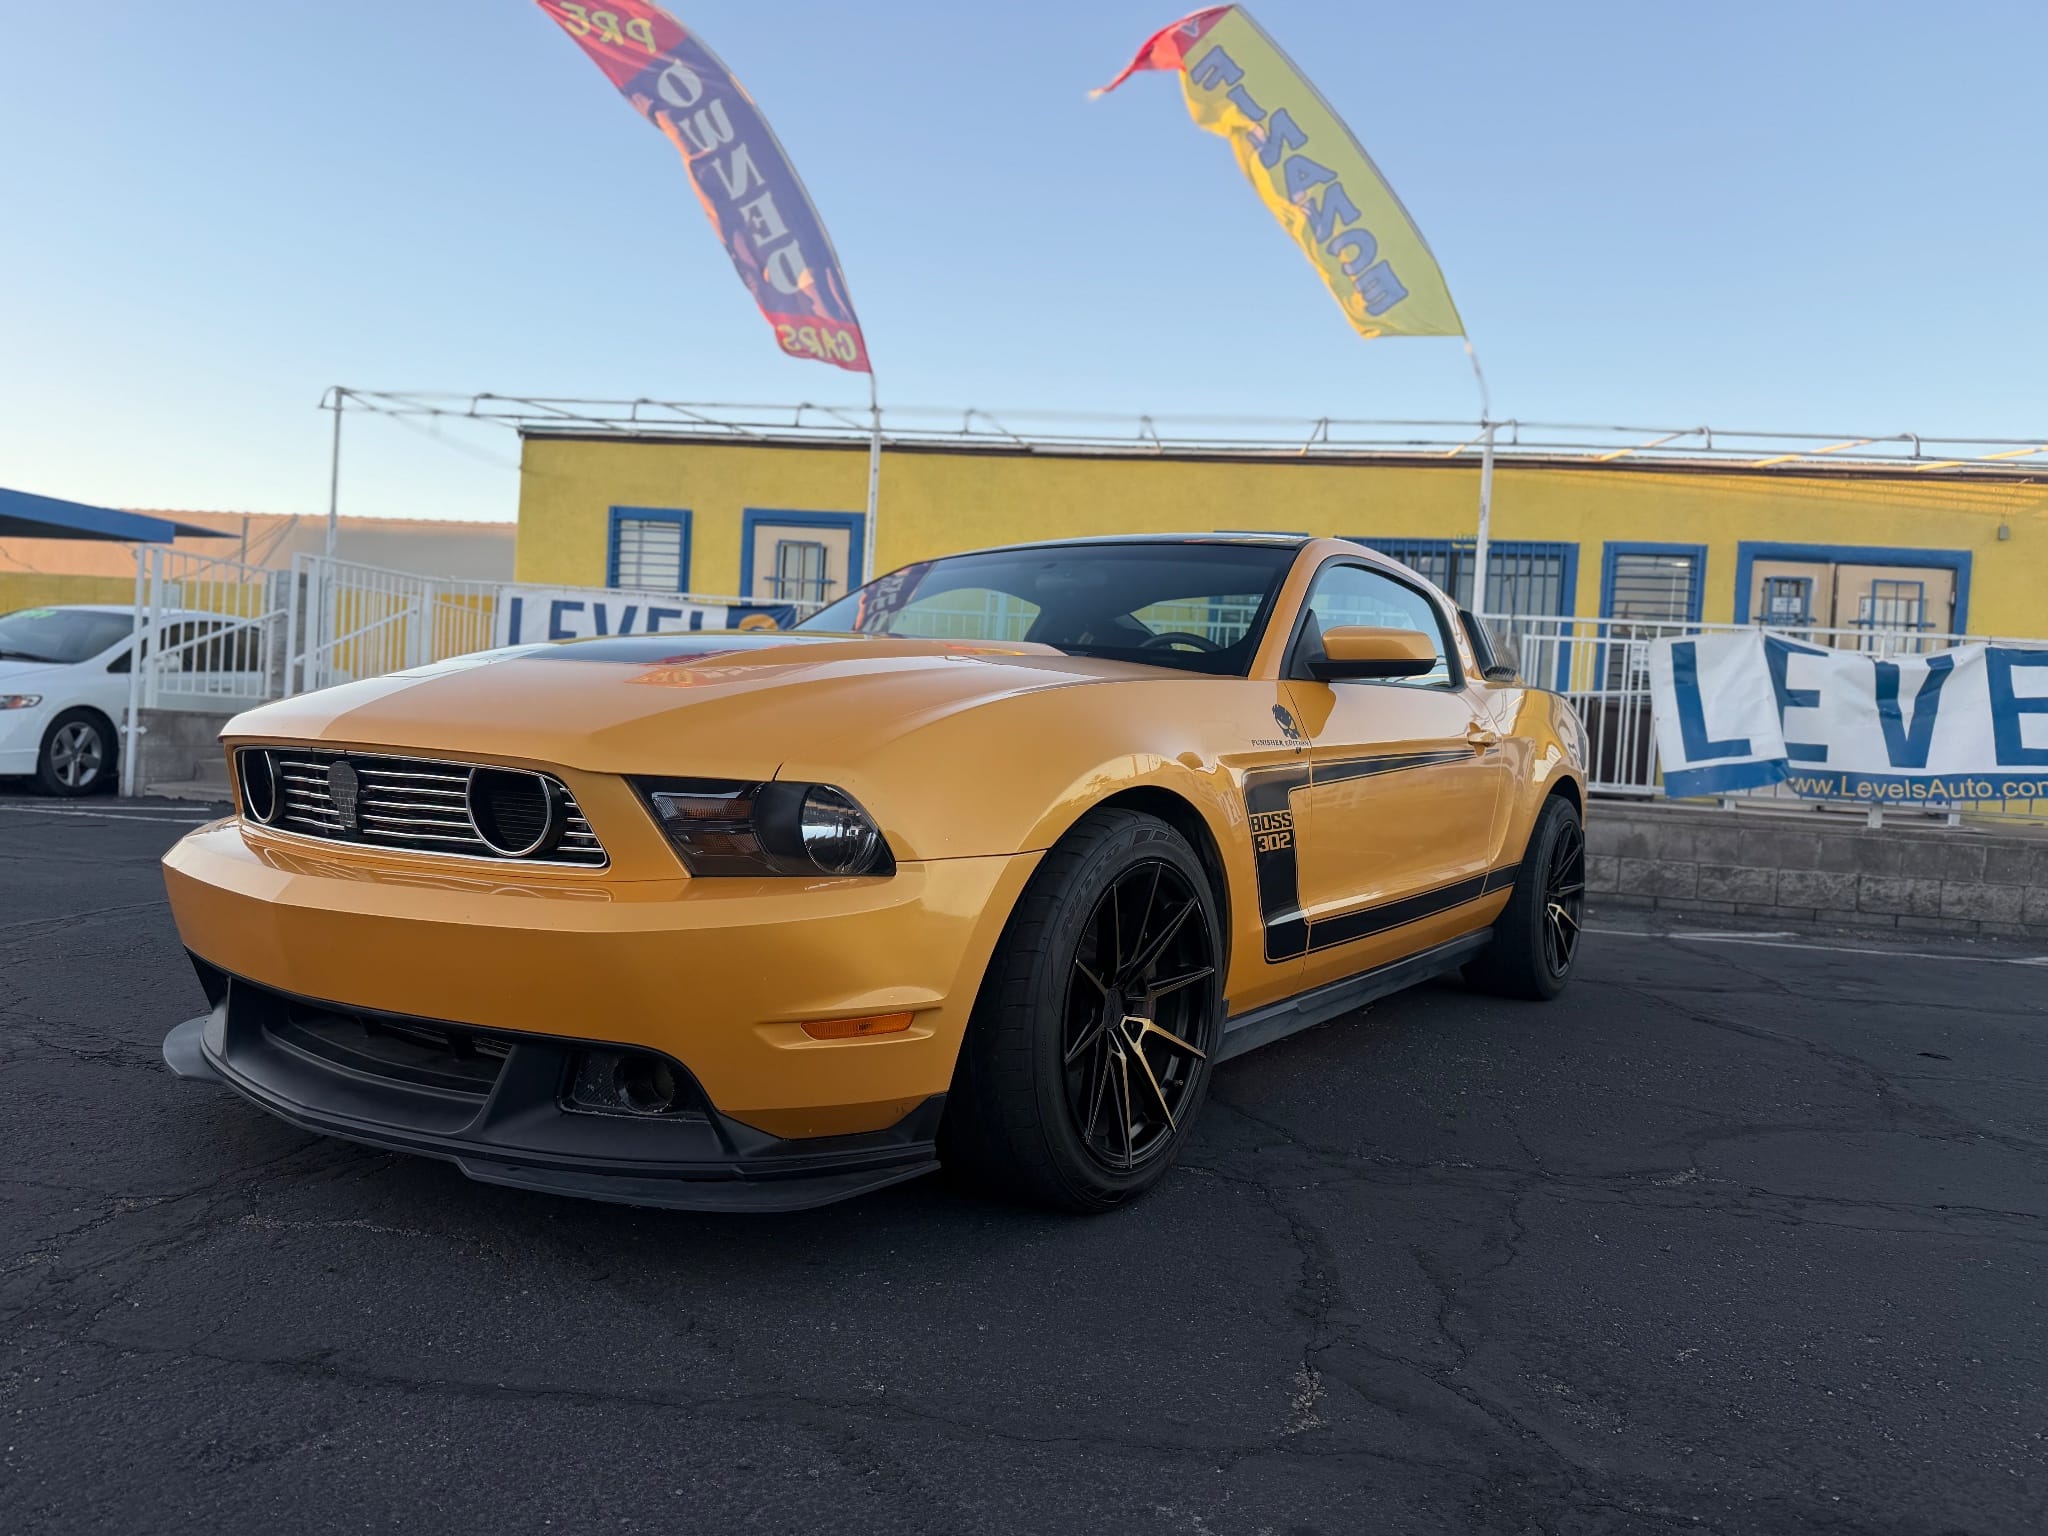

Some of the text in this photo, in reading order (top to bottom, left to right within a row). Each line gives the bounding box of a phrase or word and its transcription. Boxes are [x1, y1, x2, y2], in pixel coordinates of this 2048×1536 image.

[1671, 637, 2048, 768] LEVE
[1251, 739, 1283, 747] PUNISHER
[1250, 811, 1292, 832] BOSS
[1257, 832, 1291, 853] 302
